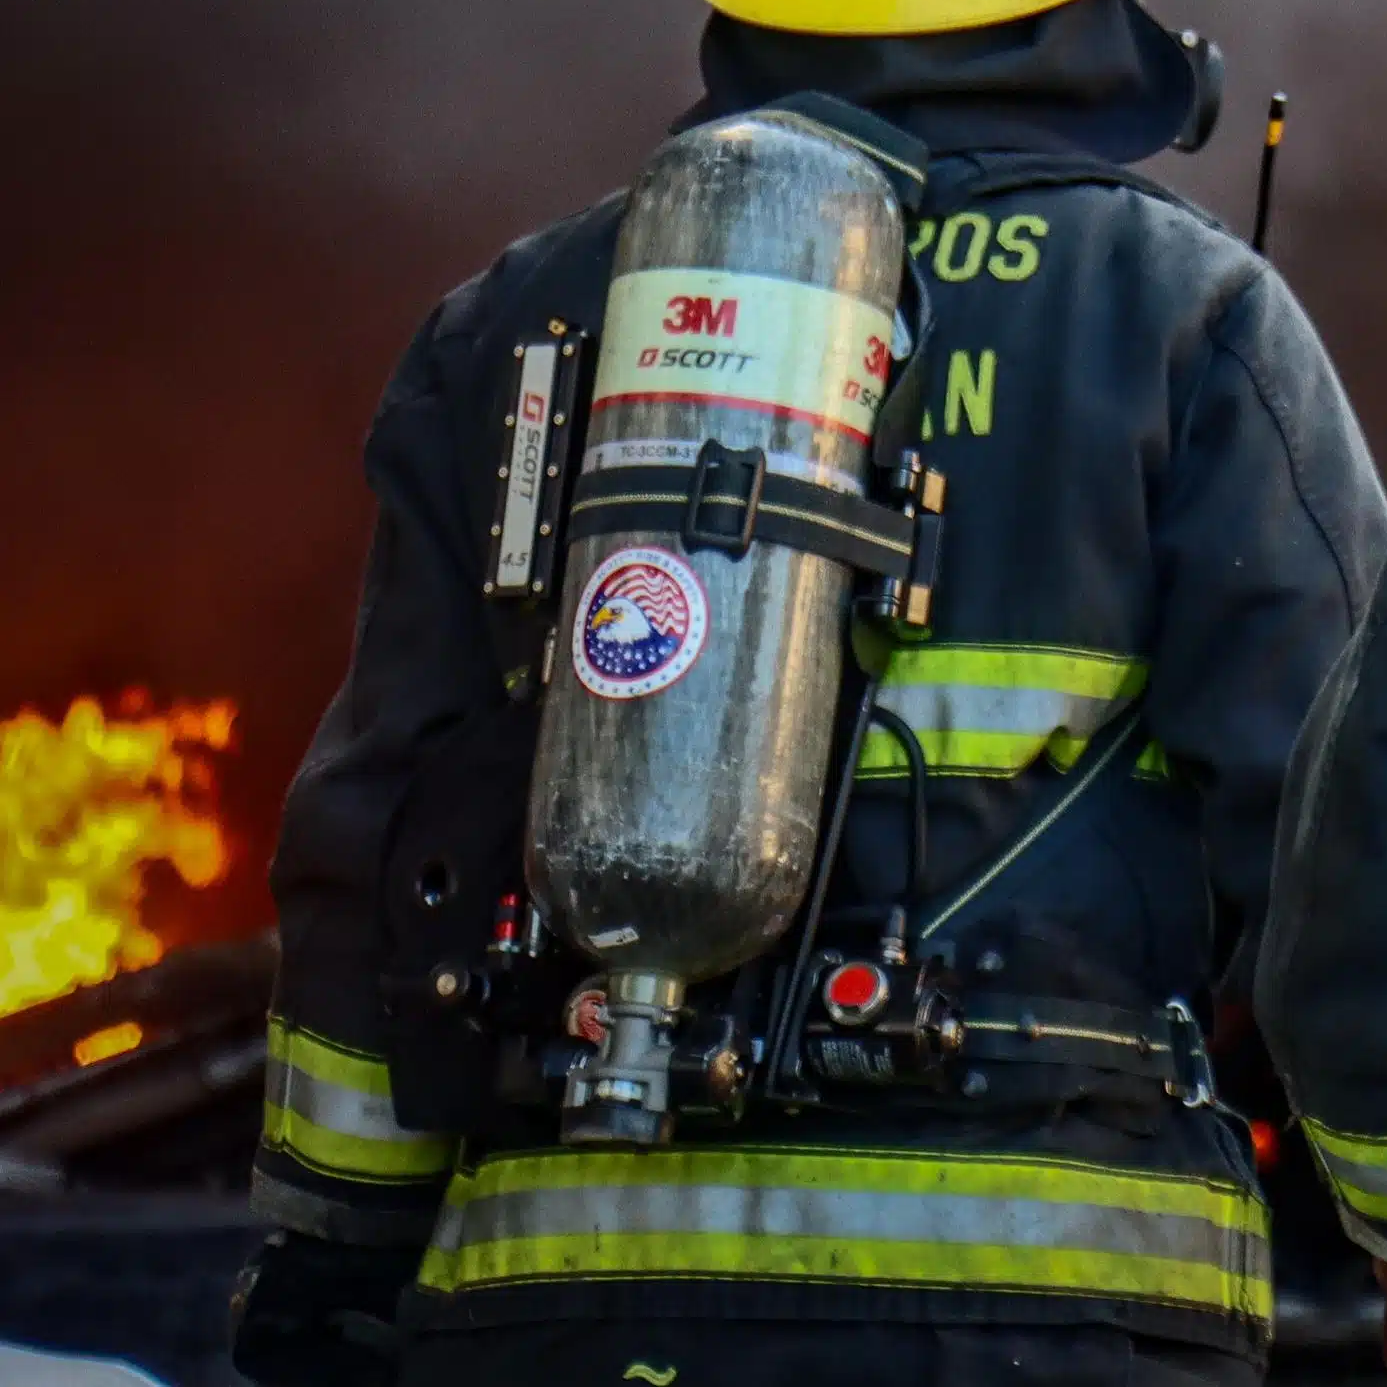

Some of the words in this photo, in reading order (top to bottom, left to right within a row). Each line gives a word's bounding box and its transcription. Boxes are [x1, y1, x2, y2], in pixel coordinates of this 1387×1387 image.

[663, 296, 738, 338] 3M
[660, 348, 753, 374] SCOTT
[920, 349, 996, 441] N
[519, 427, 541, 502] SCOTT
